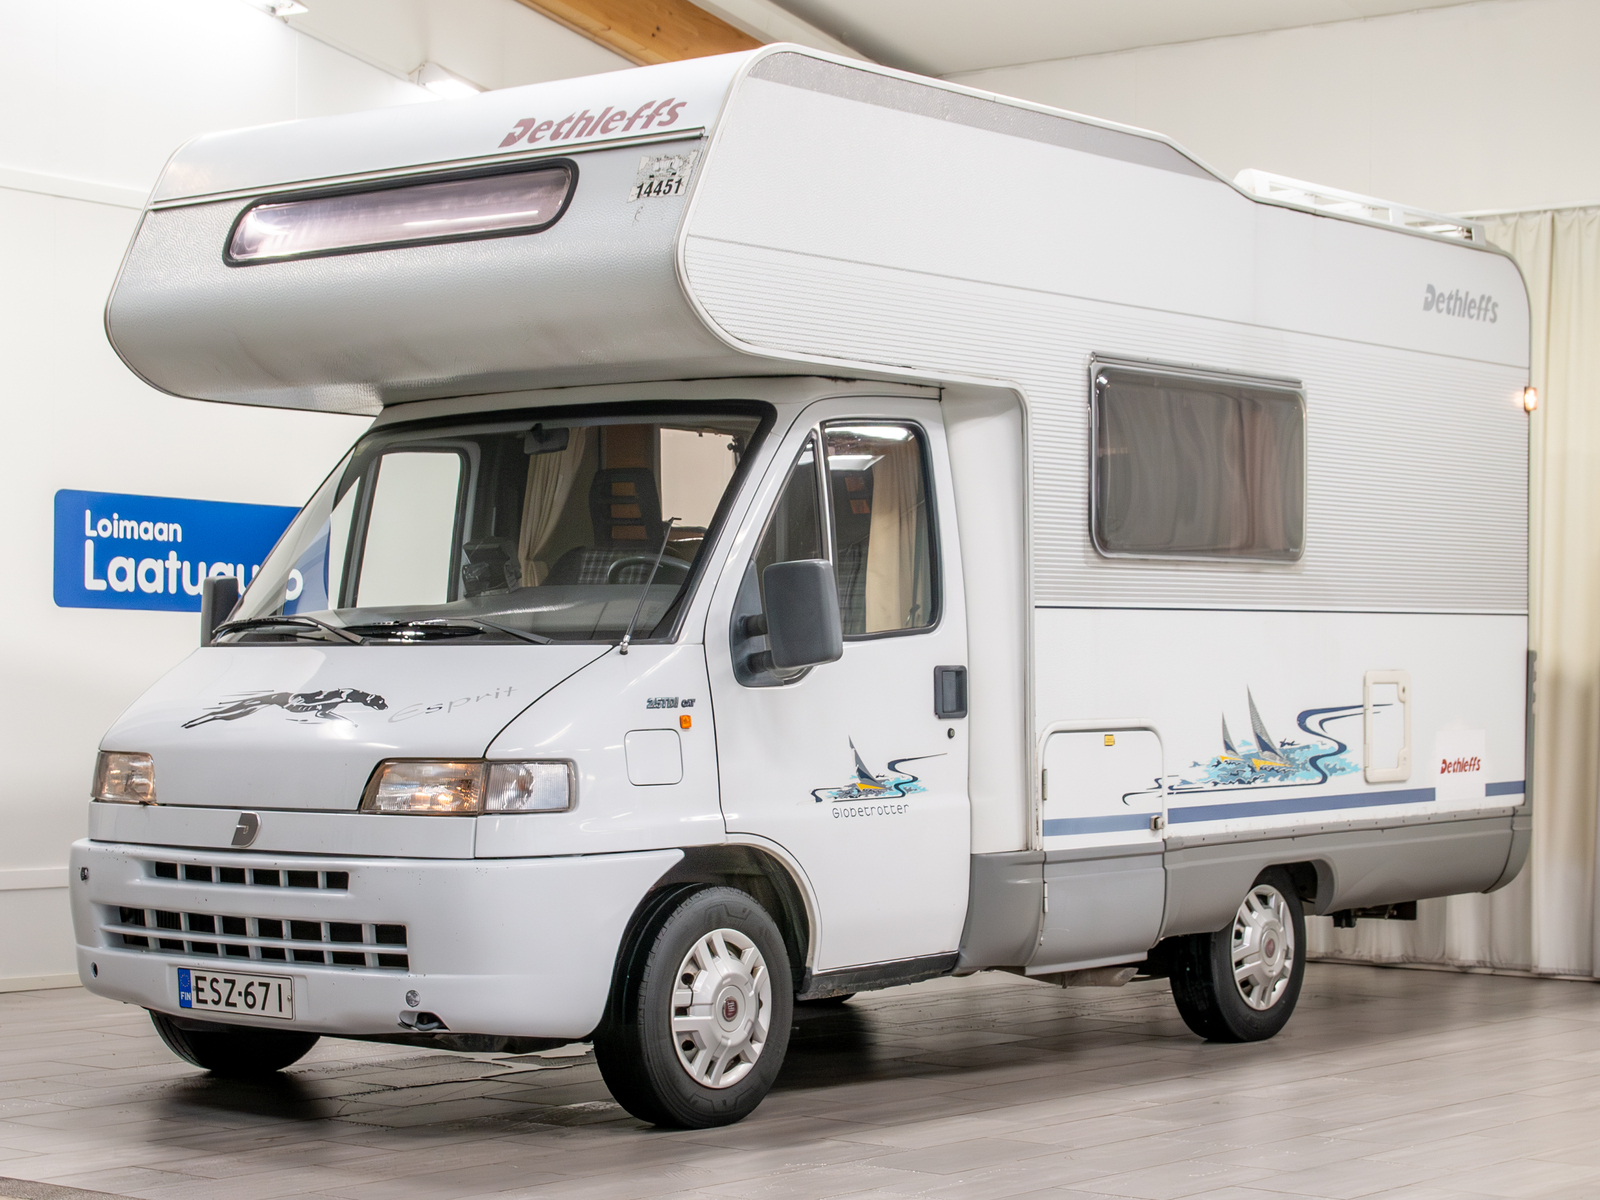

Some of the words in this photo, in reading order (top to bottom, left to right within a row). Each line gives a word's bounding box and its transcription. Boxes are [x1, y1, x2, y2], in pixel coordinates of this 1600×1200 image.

[498, 97, 688, 148] Dethleffs
[636, 177, 683, 199] 14451
[1422, 283, 1499, 324] Dethleffs
[84, 509, 183, 543] Loimaan
[84, 539, 304, 601] Laatuuo
[387, 686, 518, 723] Esprit
[1440, 756, 1481, 775] Dethleffs
[832, 804, 910, 819] Globetrotter
[180, 991, 192, 1001] FIN
[194, 975, 283, 1013] ESZ-671
